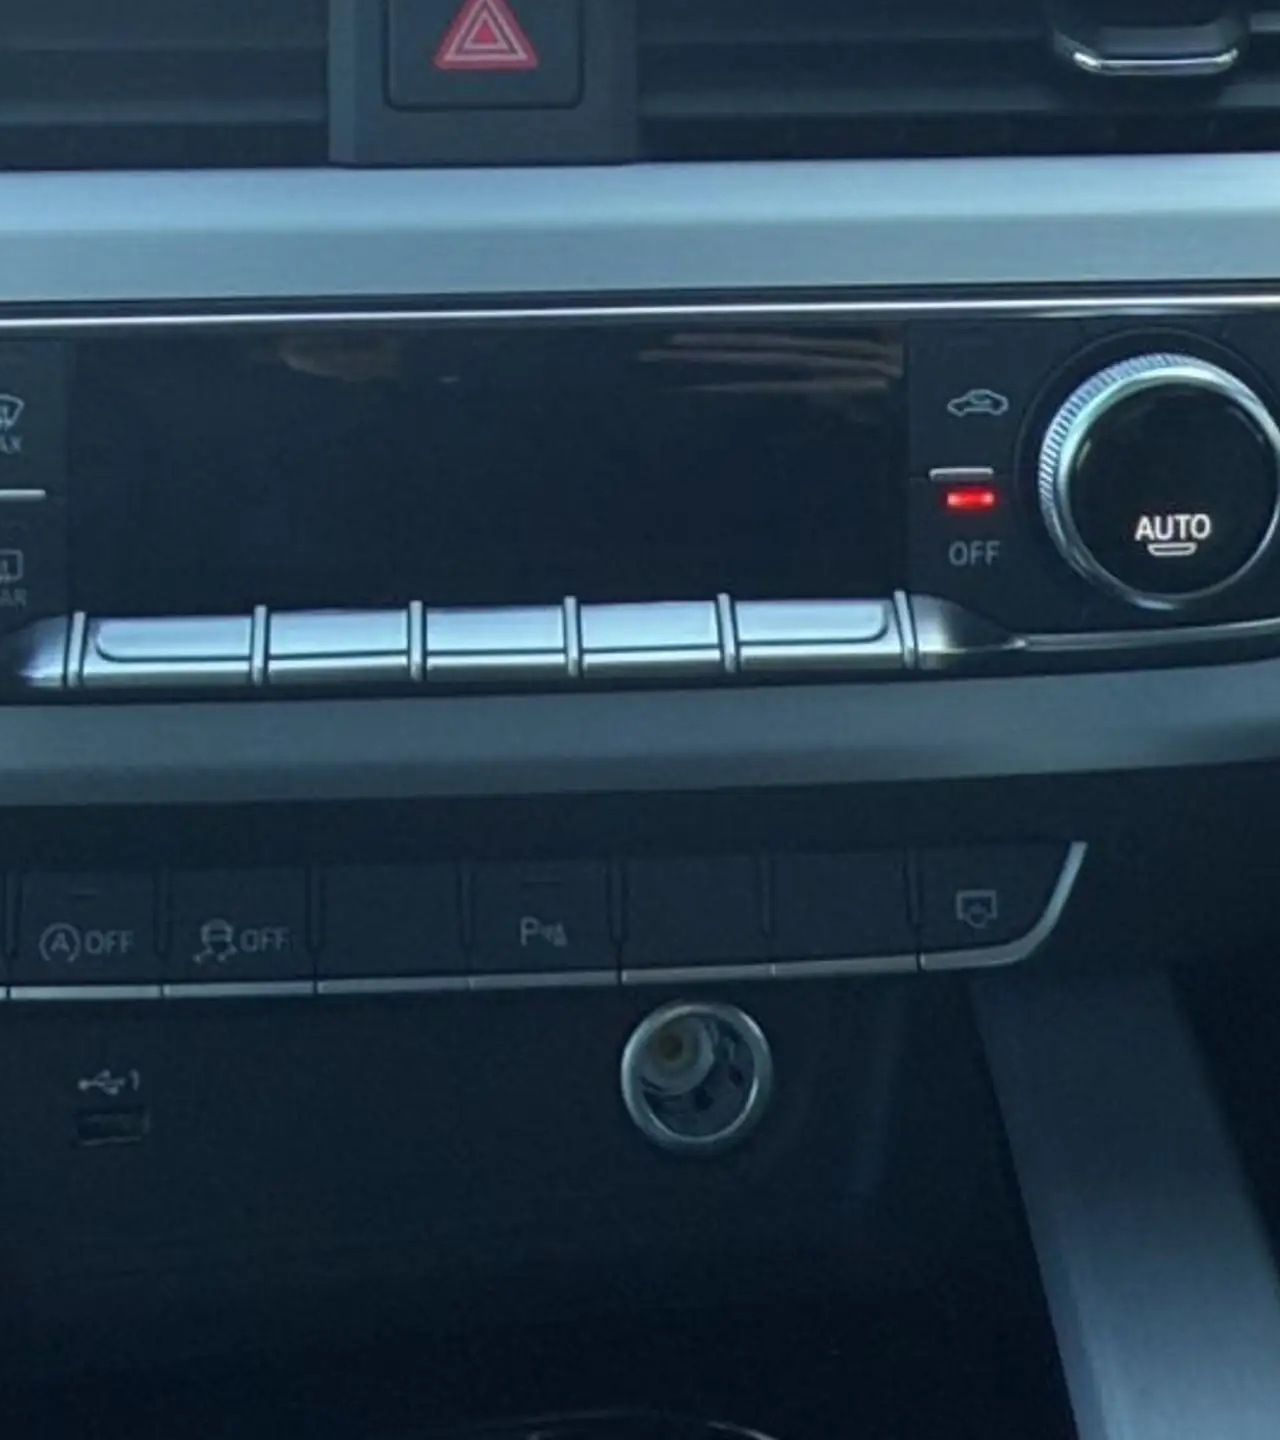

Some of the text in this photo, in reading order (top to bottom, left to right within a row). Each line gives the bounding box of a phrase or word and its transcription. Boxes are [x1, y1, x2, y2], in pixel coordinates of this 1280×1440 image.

[1134, 513, 1211, 540] AUTO
[949, 540, 1001, 567] OFF
[84, 927, 135, 956] OFF
[240, 925, 291, 954] OFF
